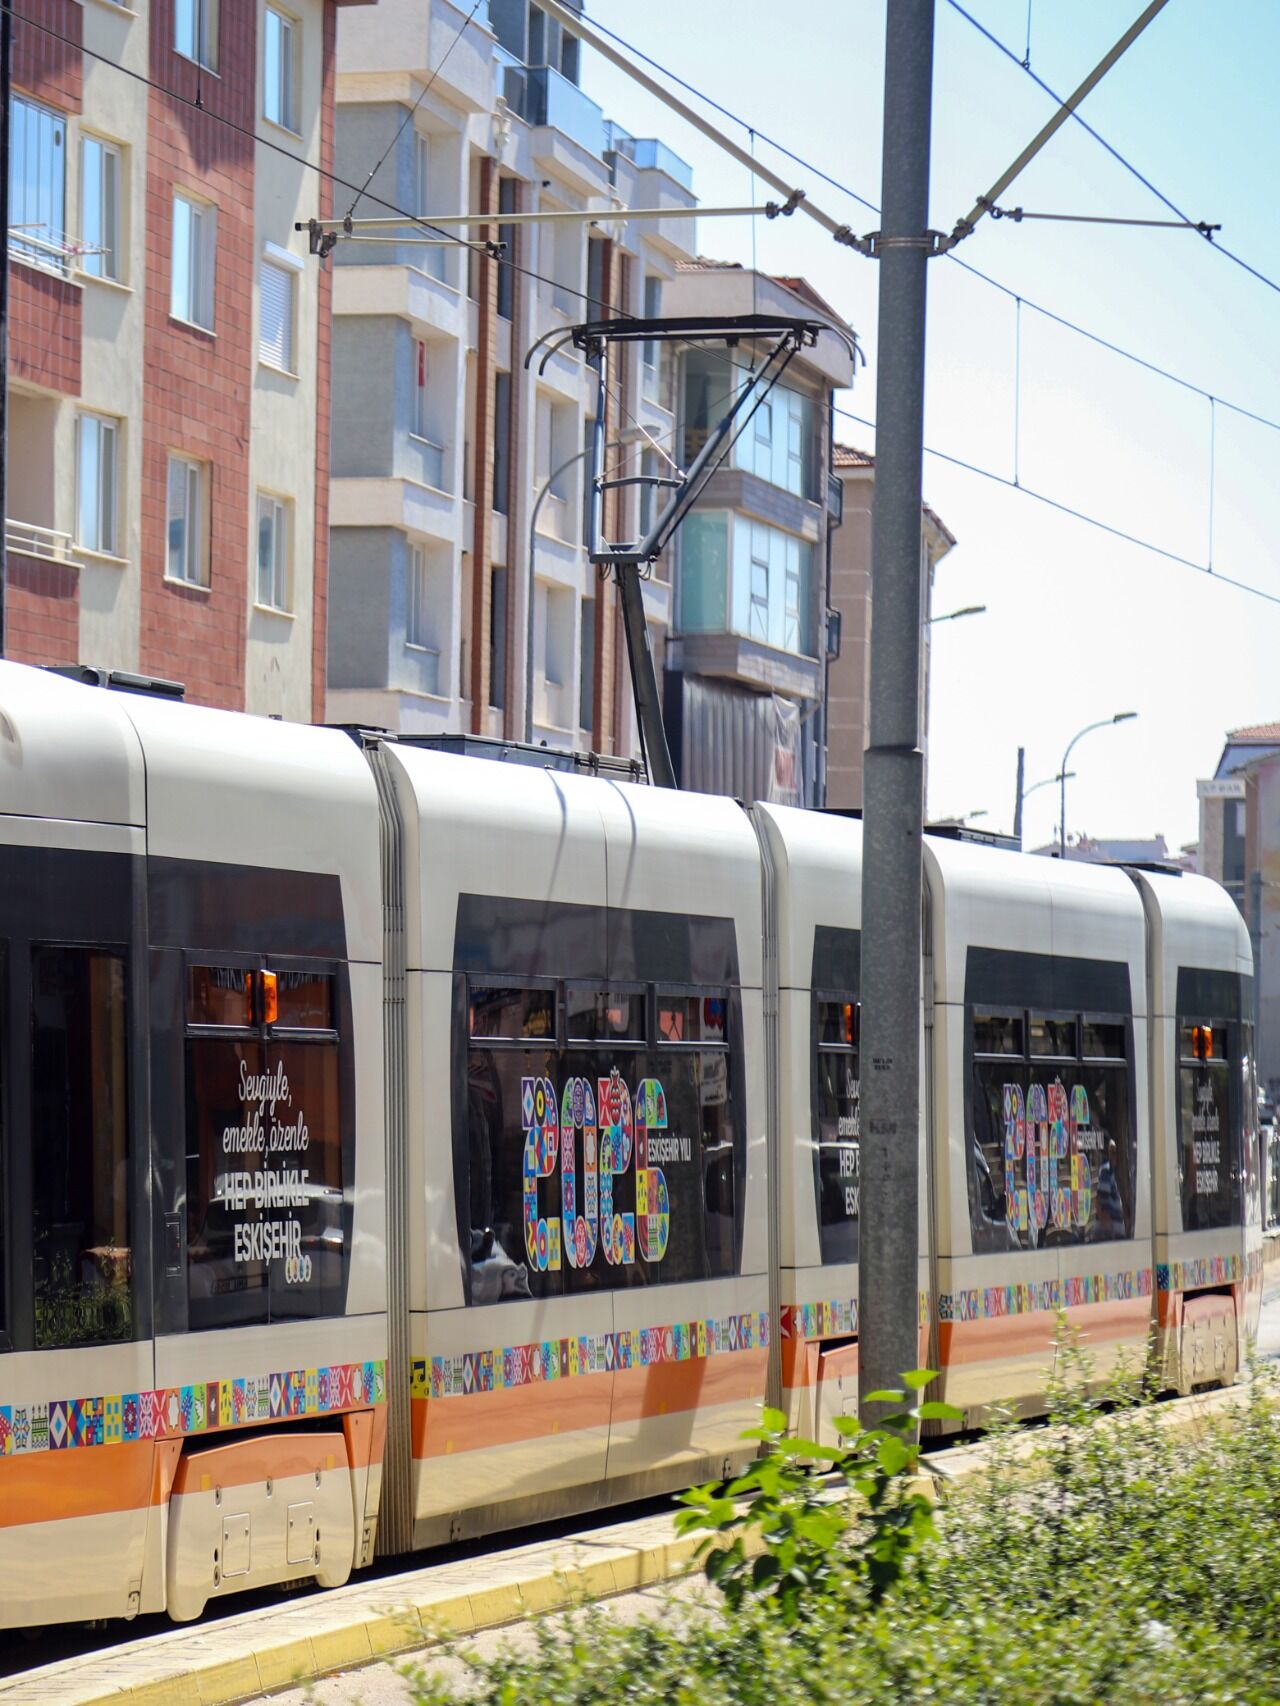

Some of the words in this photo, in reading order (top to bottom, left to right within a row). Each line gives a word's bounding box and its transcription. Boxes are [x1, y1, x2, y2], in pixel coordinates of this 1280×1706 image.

[238, 1060, 292, 1117] Sevgiyle,
[647, 1131, 679, 1167] ESKİŞEHİR
[223, 1170, 252, 1212] HEP
[254, 1160, 310, 1209] BİRLİKLE
[234, 1211, 302, 1267] ESKİŞEHİR
